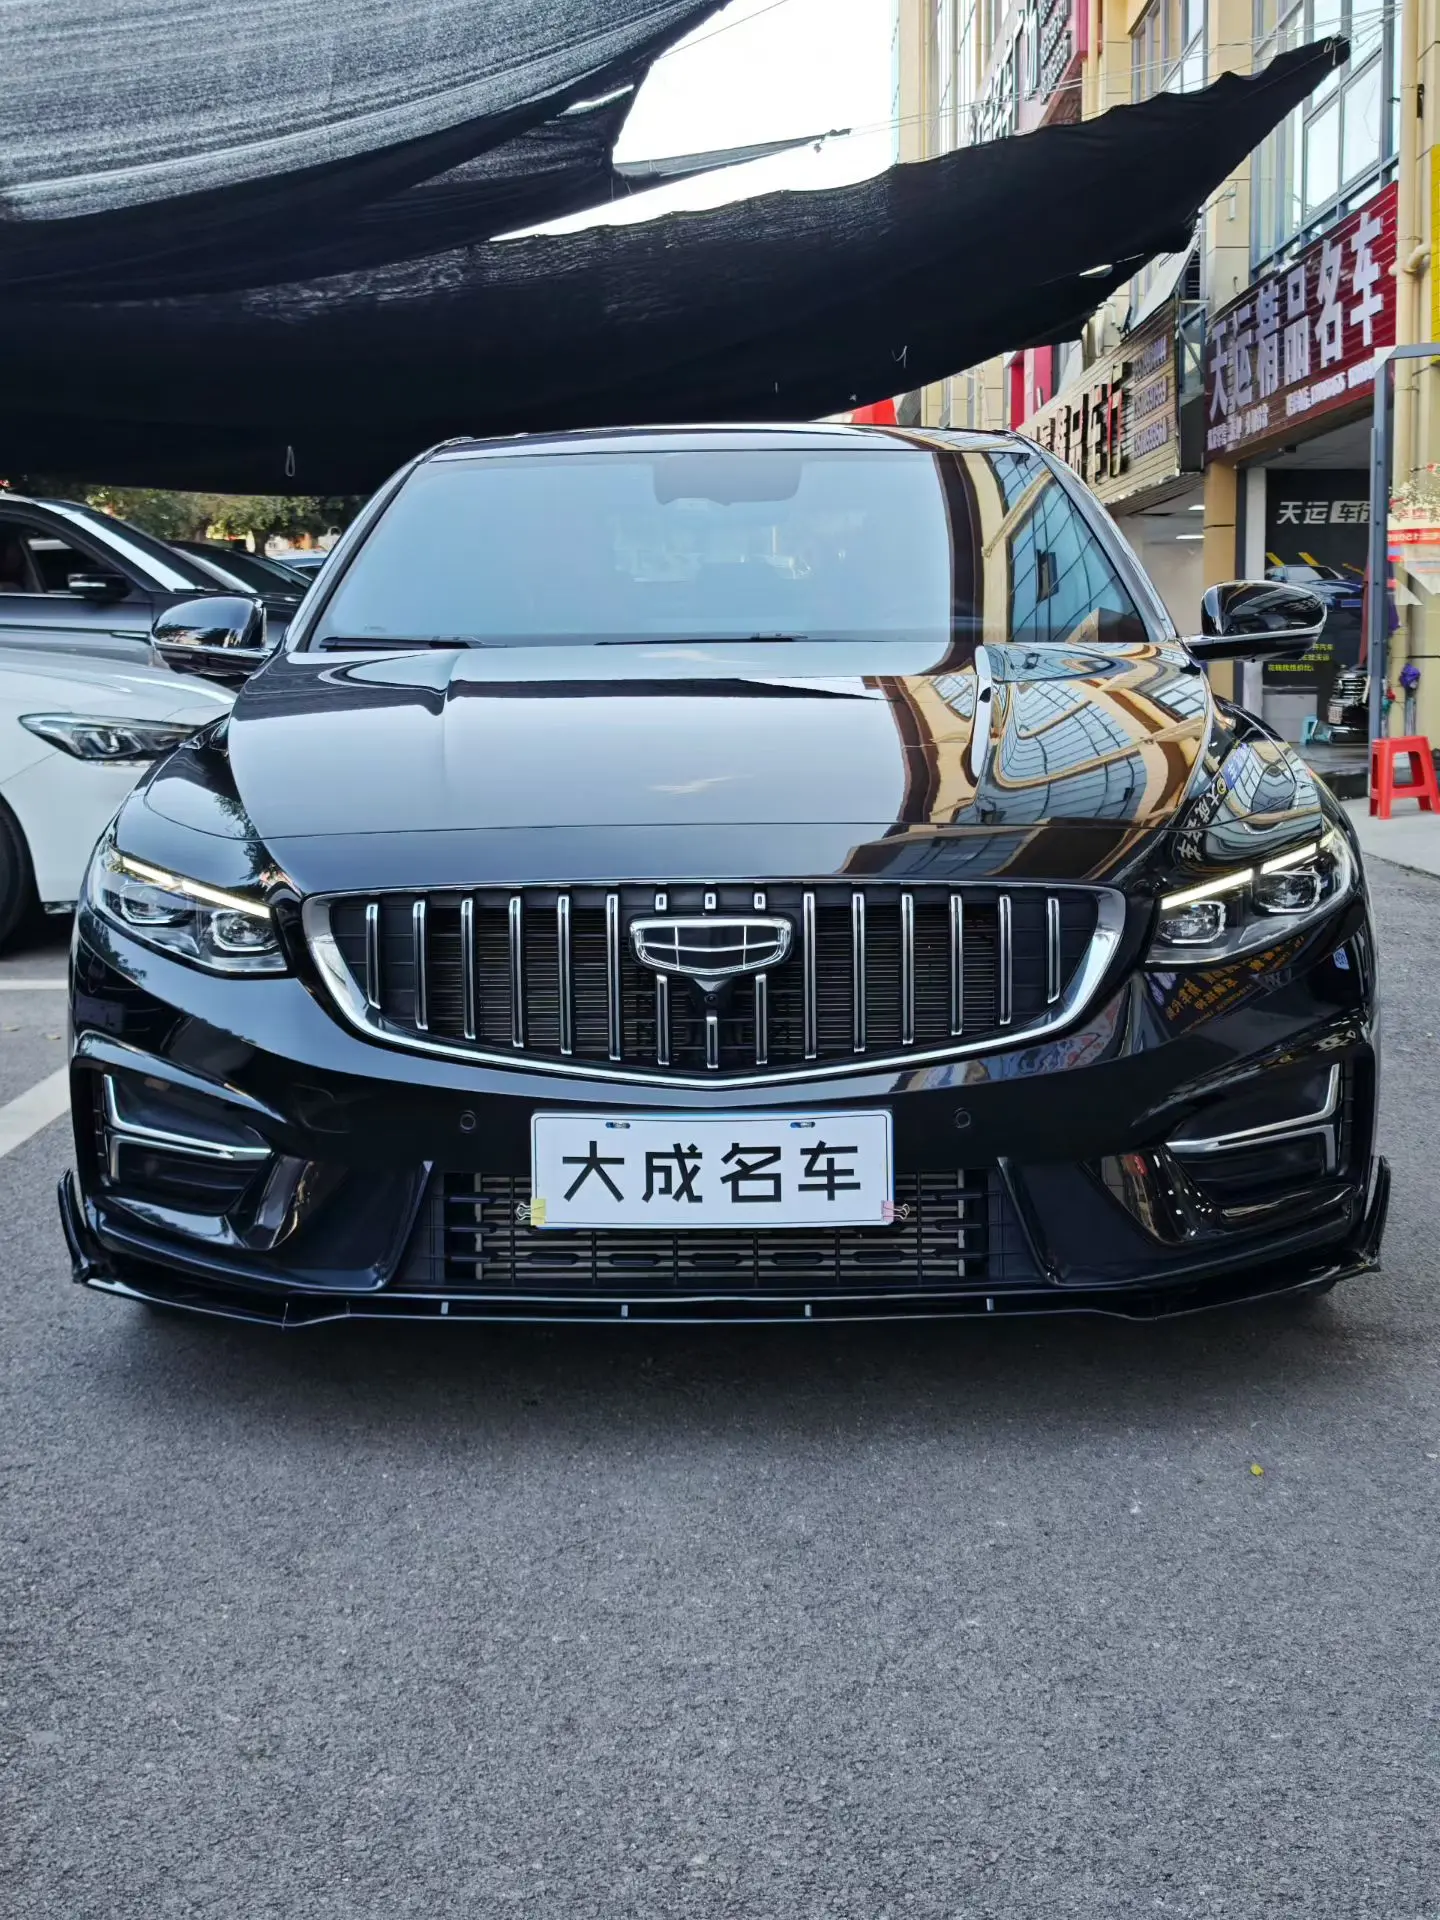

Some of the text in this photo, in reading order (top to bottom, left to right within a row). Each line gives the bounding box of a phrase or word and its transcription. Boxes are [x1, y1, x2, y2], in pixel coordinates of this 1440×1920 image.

[1208, 212, 1384, 423] 天运精品名车
[1276, 501, 1371, 524] 天运车行
[562, 1140, 861, 1203] 大成名车
